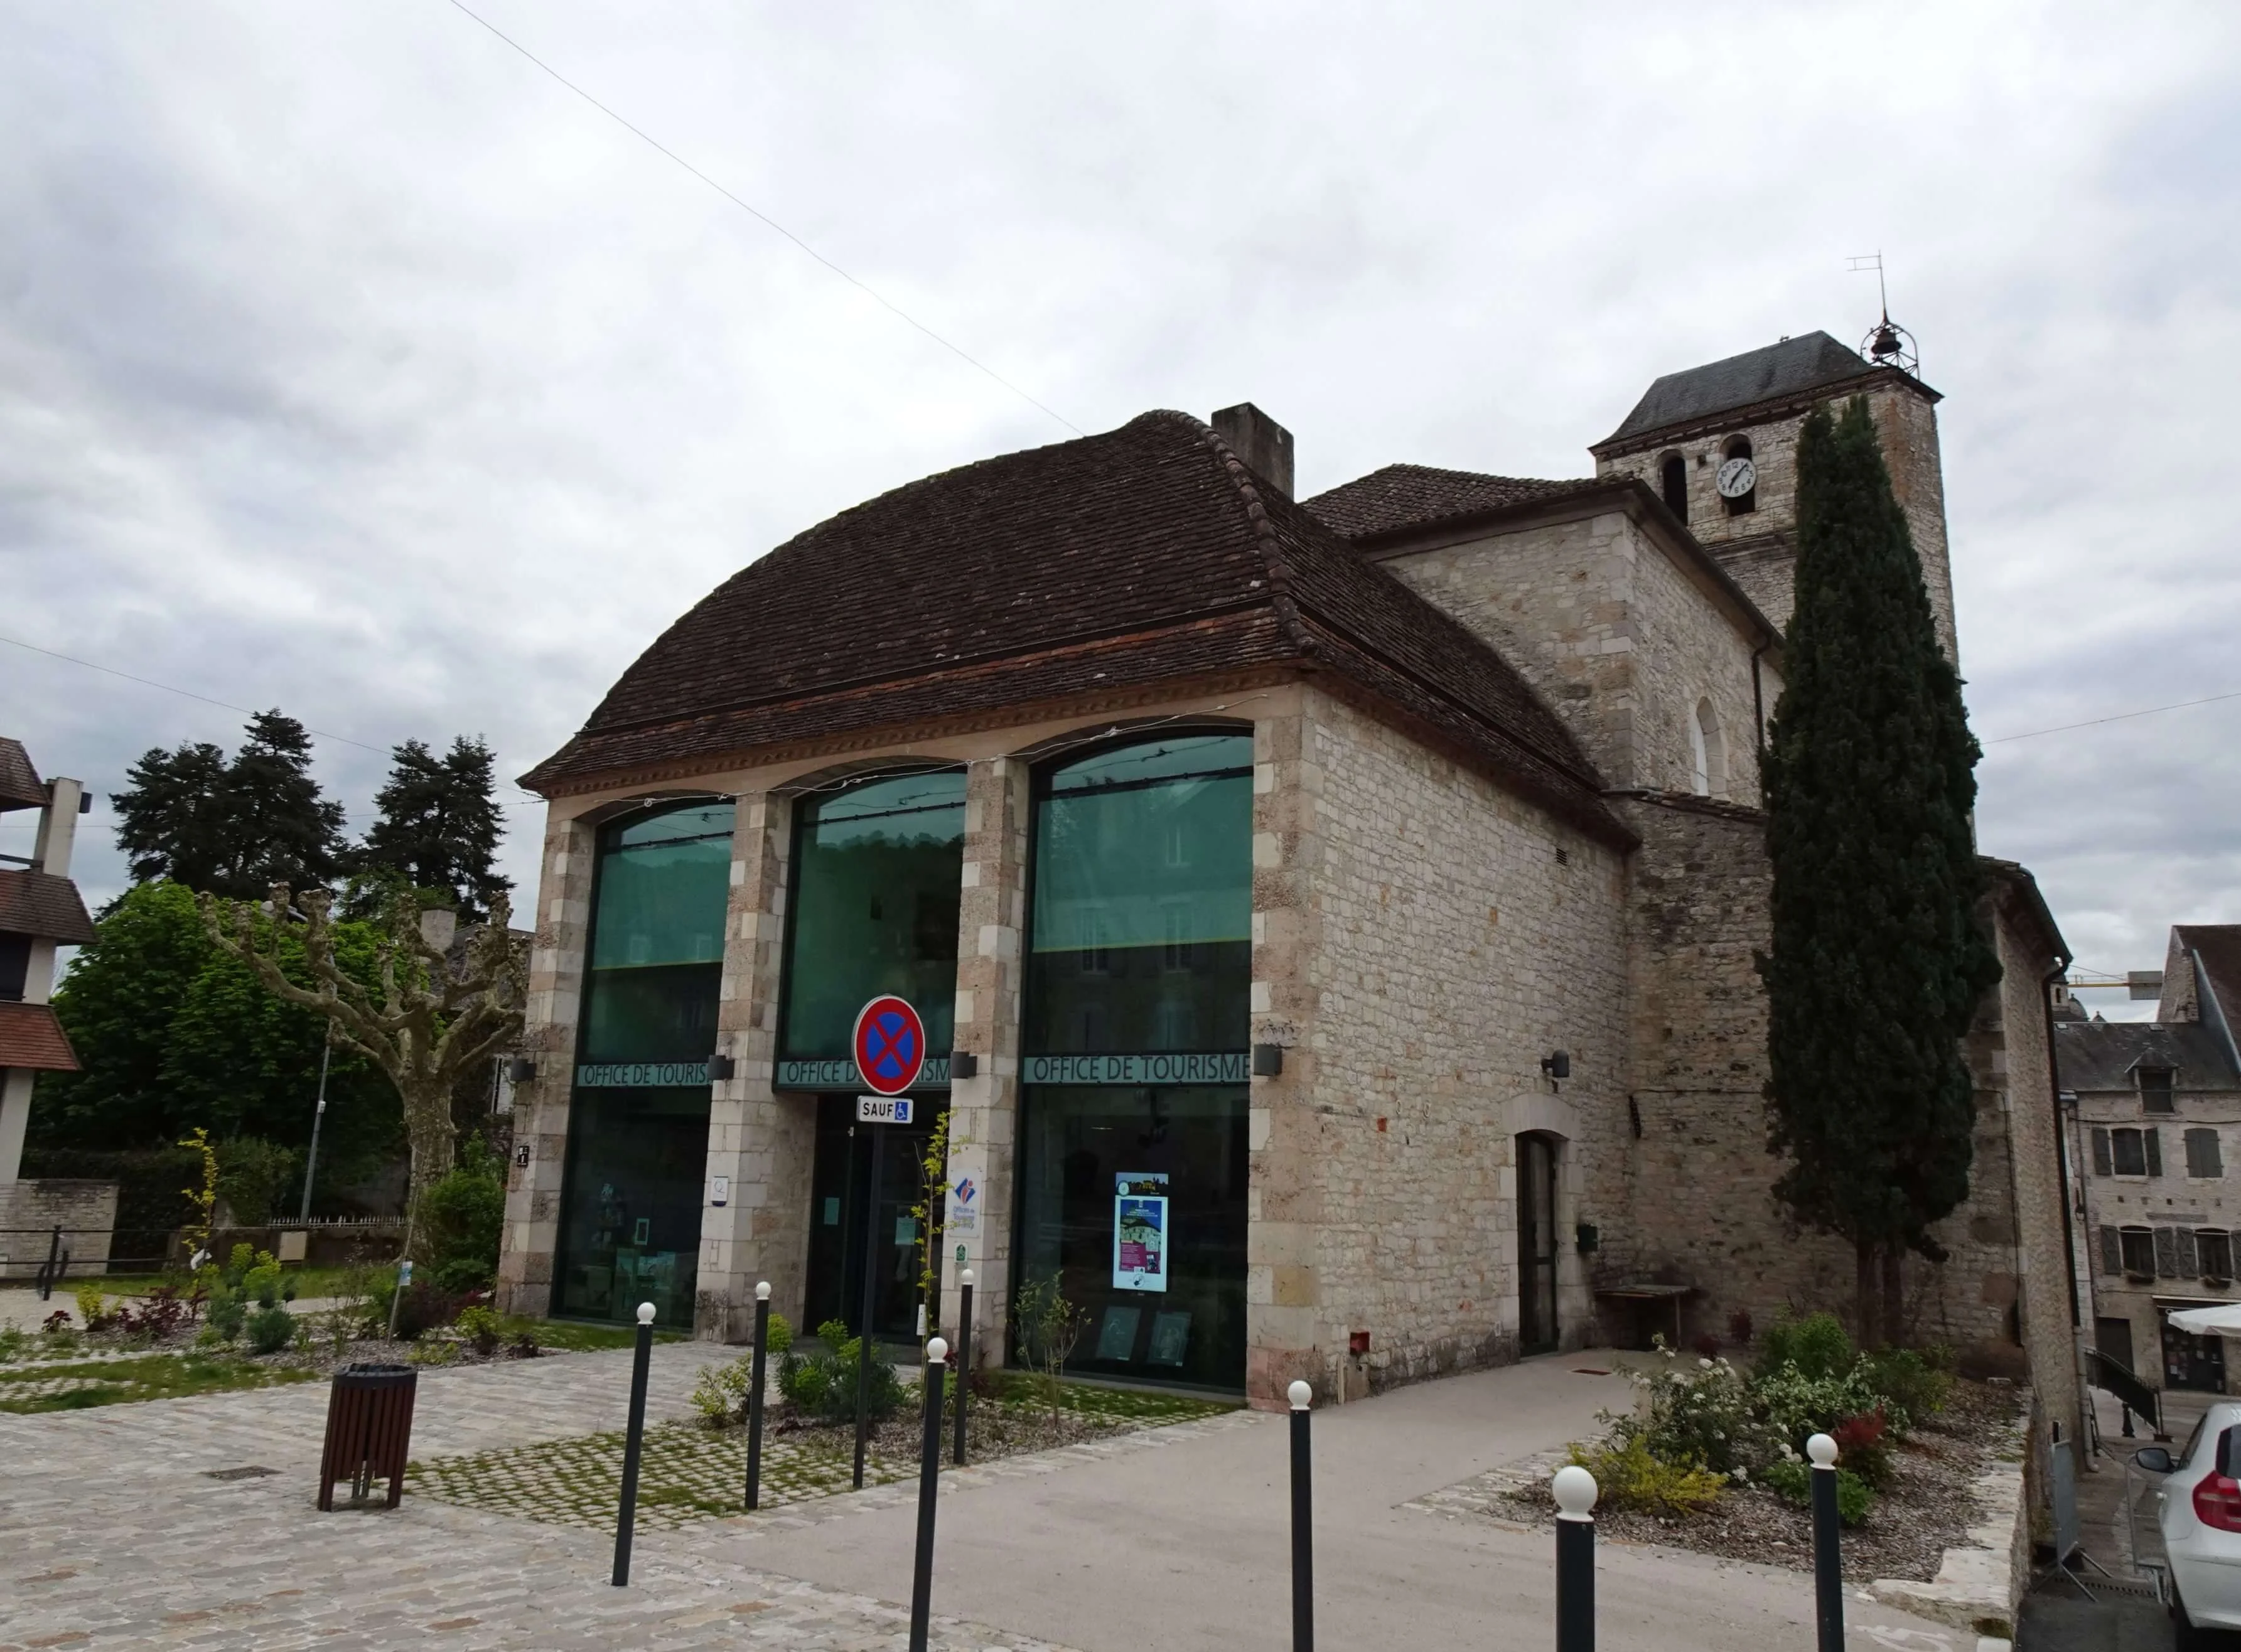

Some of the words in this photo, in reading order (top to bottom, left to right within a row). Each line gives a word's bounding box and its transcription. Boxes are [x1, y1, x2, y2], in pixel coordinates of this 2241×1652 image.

[584, 1065, 628, 1085] OFFICE
[633, 1065, 650, 1084] DE
[657, 1063, 709, 1083] TOURIS
[787, 1061, 839, 1082] OFFICE
[1034, 1056, 1099, 1081] OFFICE
[1107, 1056, 1133, 1080] DE
[1139, 1054, 1250, 1080] TOURISME
[863, 1102, 894, 1117] SAUF
